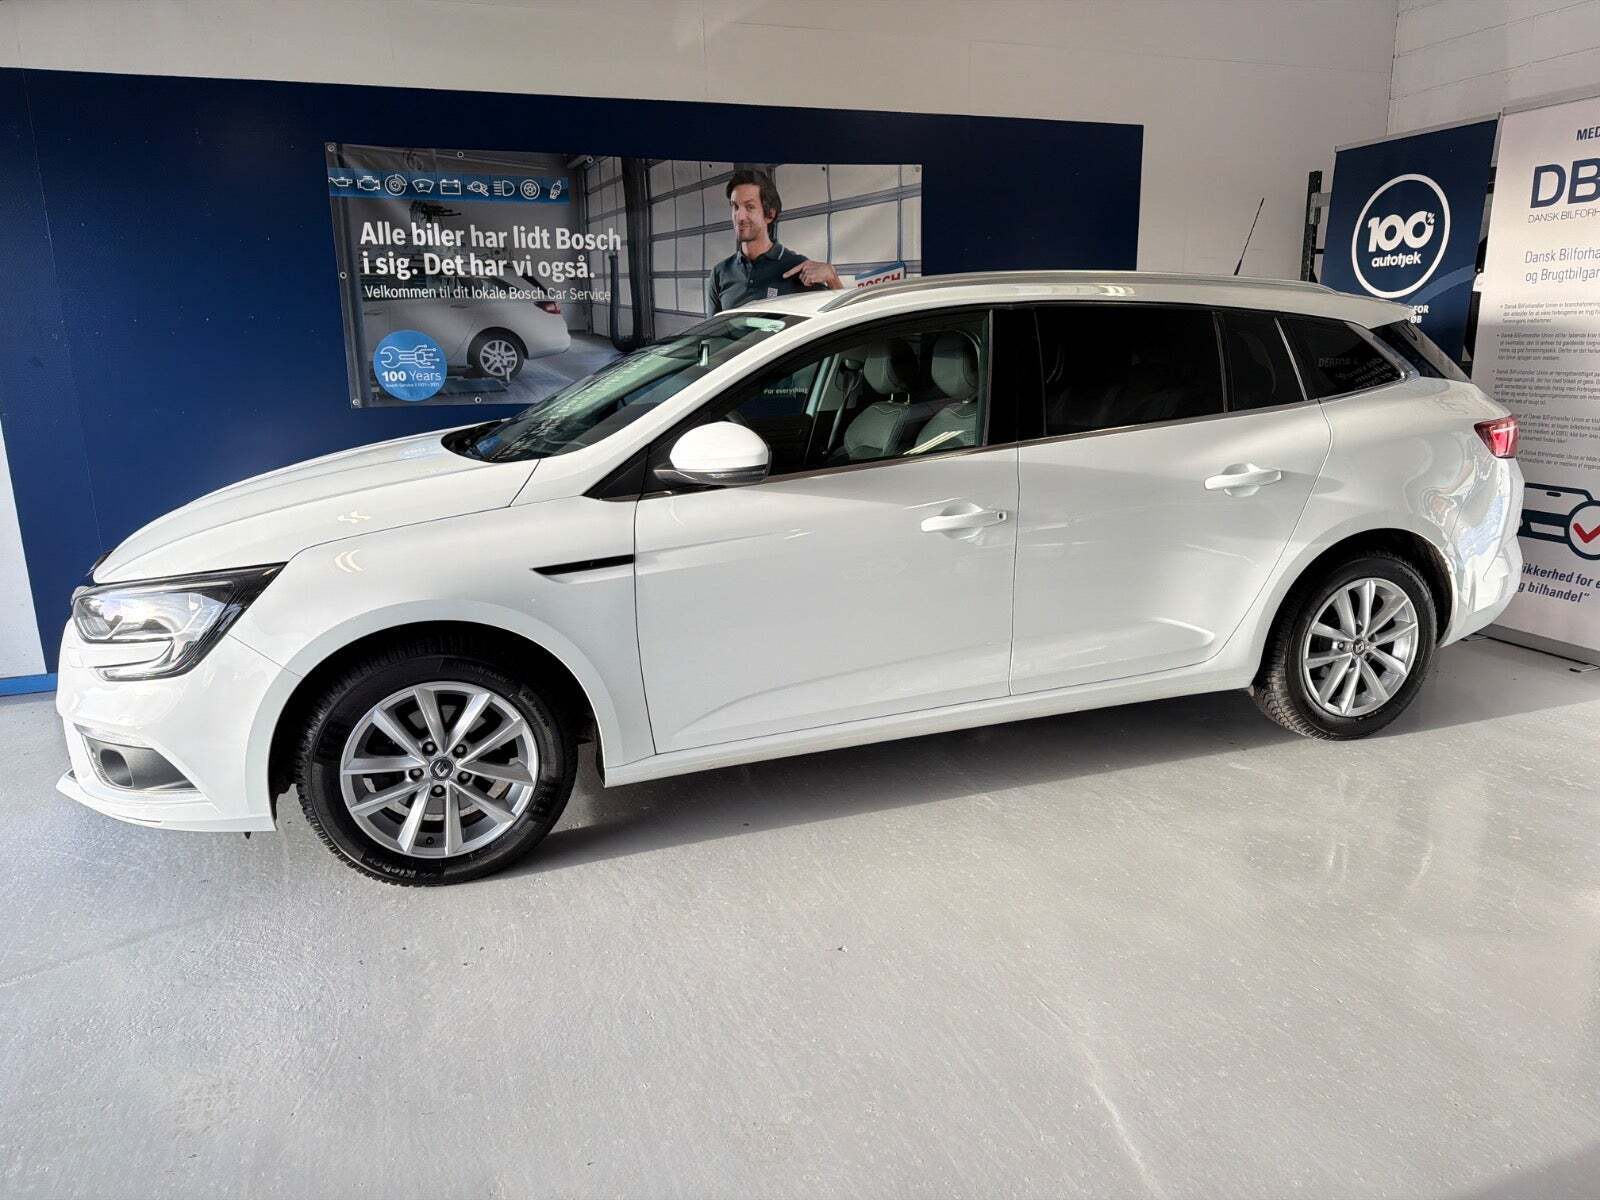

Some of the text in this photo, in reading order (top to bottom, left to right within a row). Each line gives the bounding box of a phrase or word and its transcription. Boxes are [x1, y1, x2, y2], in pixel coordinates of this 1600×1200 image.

[1528, 211, 1560, 223] DANSK
[360, 221, 621, 250] Alle biler har lidt Bosch
[1371, 251, 1421, 268] autotjek
[1525, 249, 1557, 264] Dansk
[362, 251, 596, 282] i sig. Det har vi også.
[1525, 271, 1538, 284] og
[364, 284, 611, 300] Velkommen til dit lokale Bosch Car Service
[382, 370, 441, 382] 100 Years
[1575, 574, 1593, 587] for
